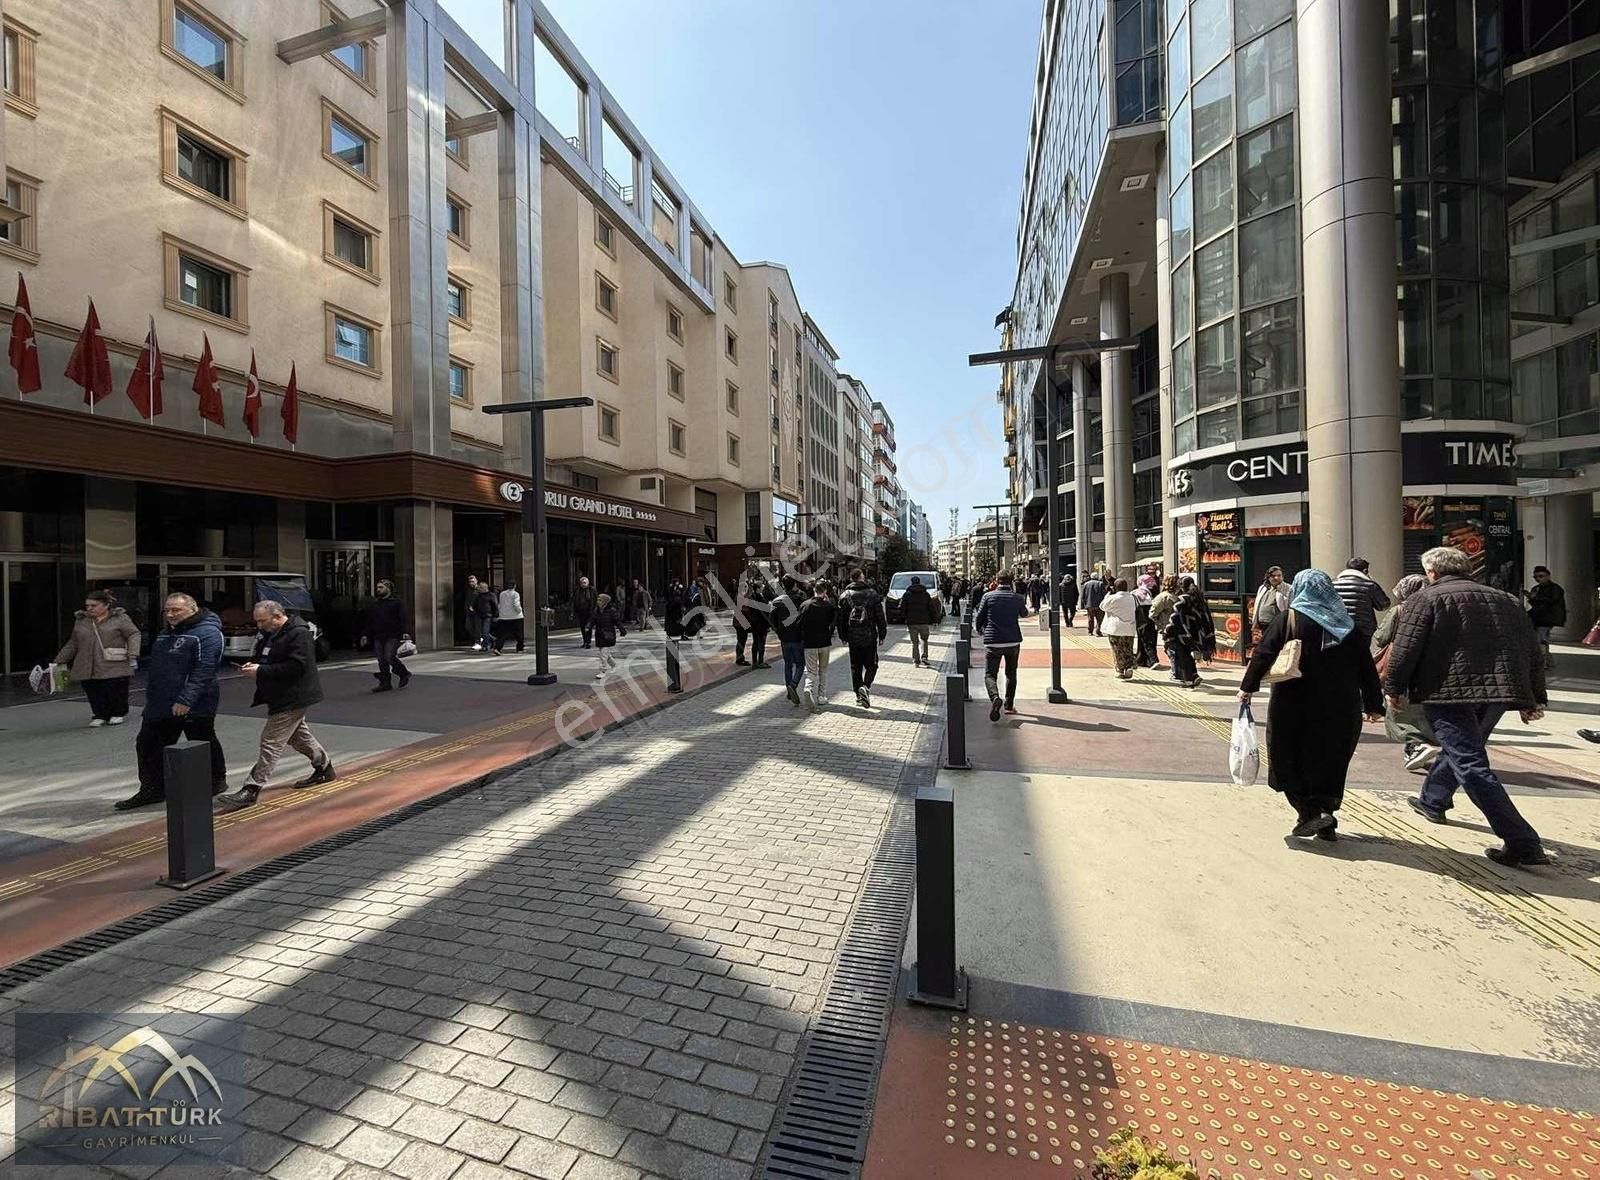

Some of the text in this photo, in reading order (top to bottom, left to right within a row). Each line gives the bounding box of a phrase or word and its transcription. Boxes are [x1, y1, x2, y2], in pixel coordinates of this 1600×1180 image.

[1227, 451, 1308, 481] CENT
[543, 490, 634, 520] ORLU GRAND HOTEL
